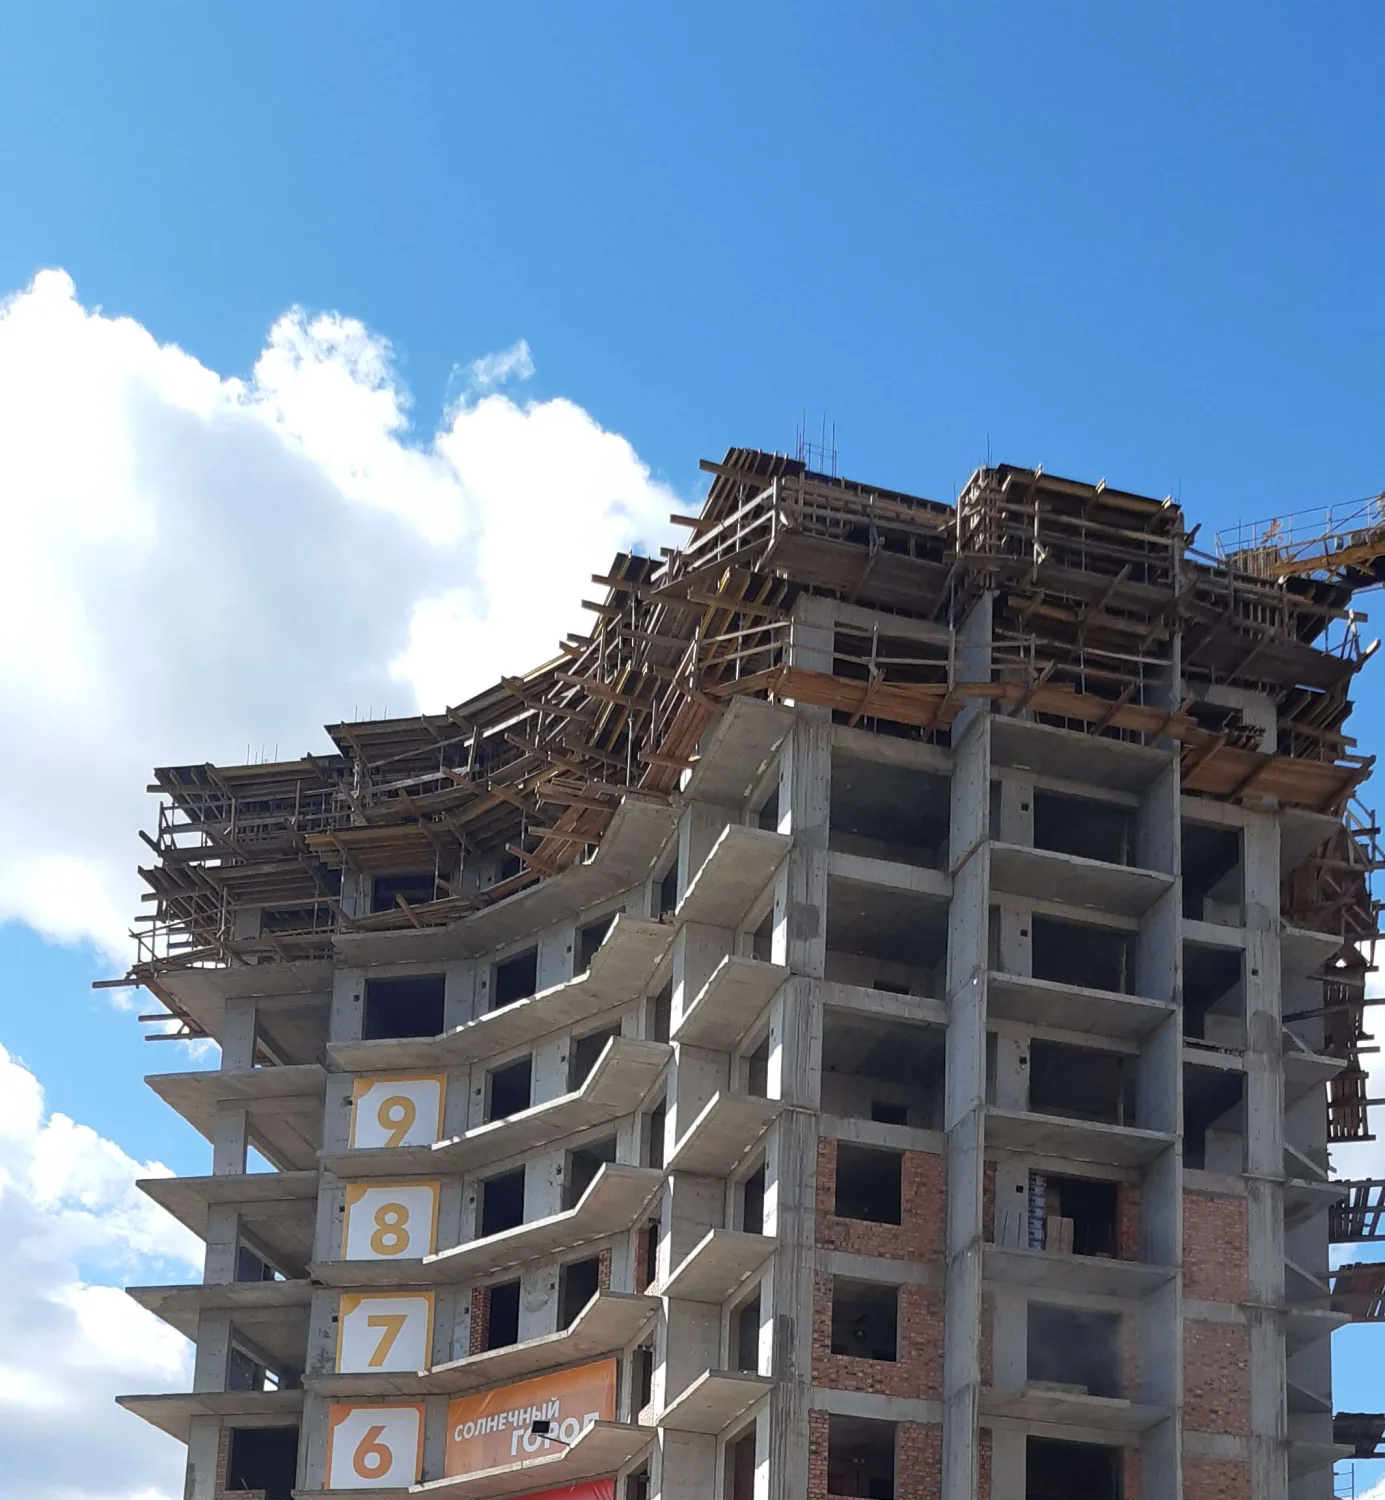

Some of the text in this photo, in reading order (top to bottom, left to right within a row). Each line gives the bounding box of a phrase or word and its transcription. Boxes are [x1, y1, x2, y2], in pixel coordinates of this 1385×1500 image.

[377, 1095, 416, 1147] 9
[371, 1203, 410, 1255] 8
[367, 1315, 407, 1367] 7
[454, 1397, 560, 1441] СОЛНЕЧНЫЙ
[353, 1425, 393, 1479] 6
